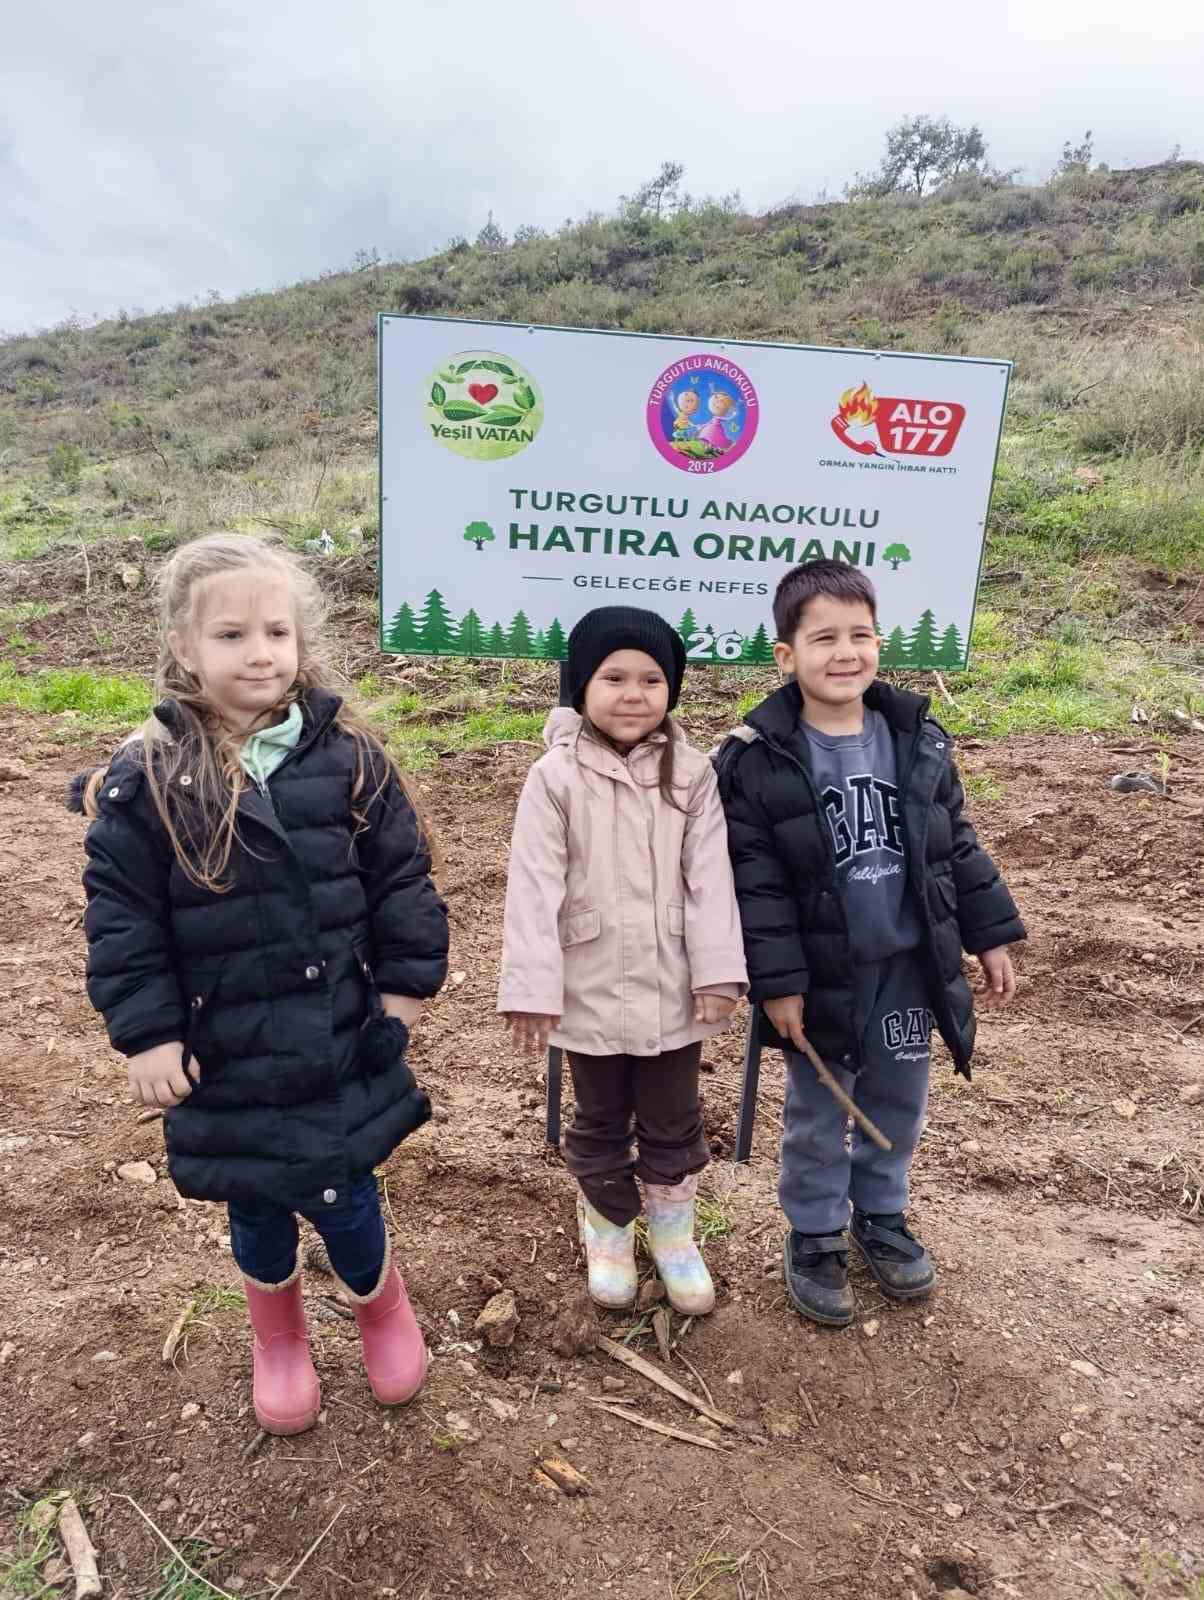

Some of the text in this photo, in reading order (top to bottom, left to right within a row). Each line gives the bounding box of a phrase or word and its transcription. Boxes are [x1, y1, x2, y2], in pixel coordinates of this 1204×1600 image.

[649, 358, 757, 407] TURGUTLU ANAOKULU
[889, 402, 953, 426] ALO
[430, 424, 534, 442] Yeşil VATAN
[890, 427, 948, 452] 177
[688, 460, 714, 473] 2012
[818, 459, 855, 469] ORMAN
[859, 462, 895, 471] YANGIN
[929, 466, 957, 475] HATTI
[509, 489, 880, 528] TURGUTLU ANAOKULU
[509, 522, 875, 567] HATIRA ORMANI
[573, 574, 768, 595] GELECEĞE NEFES
